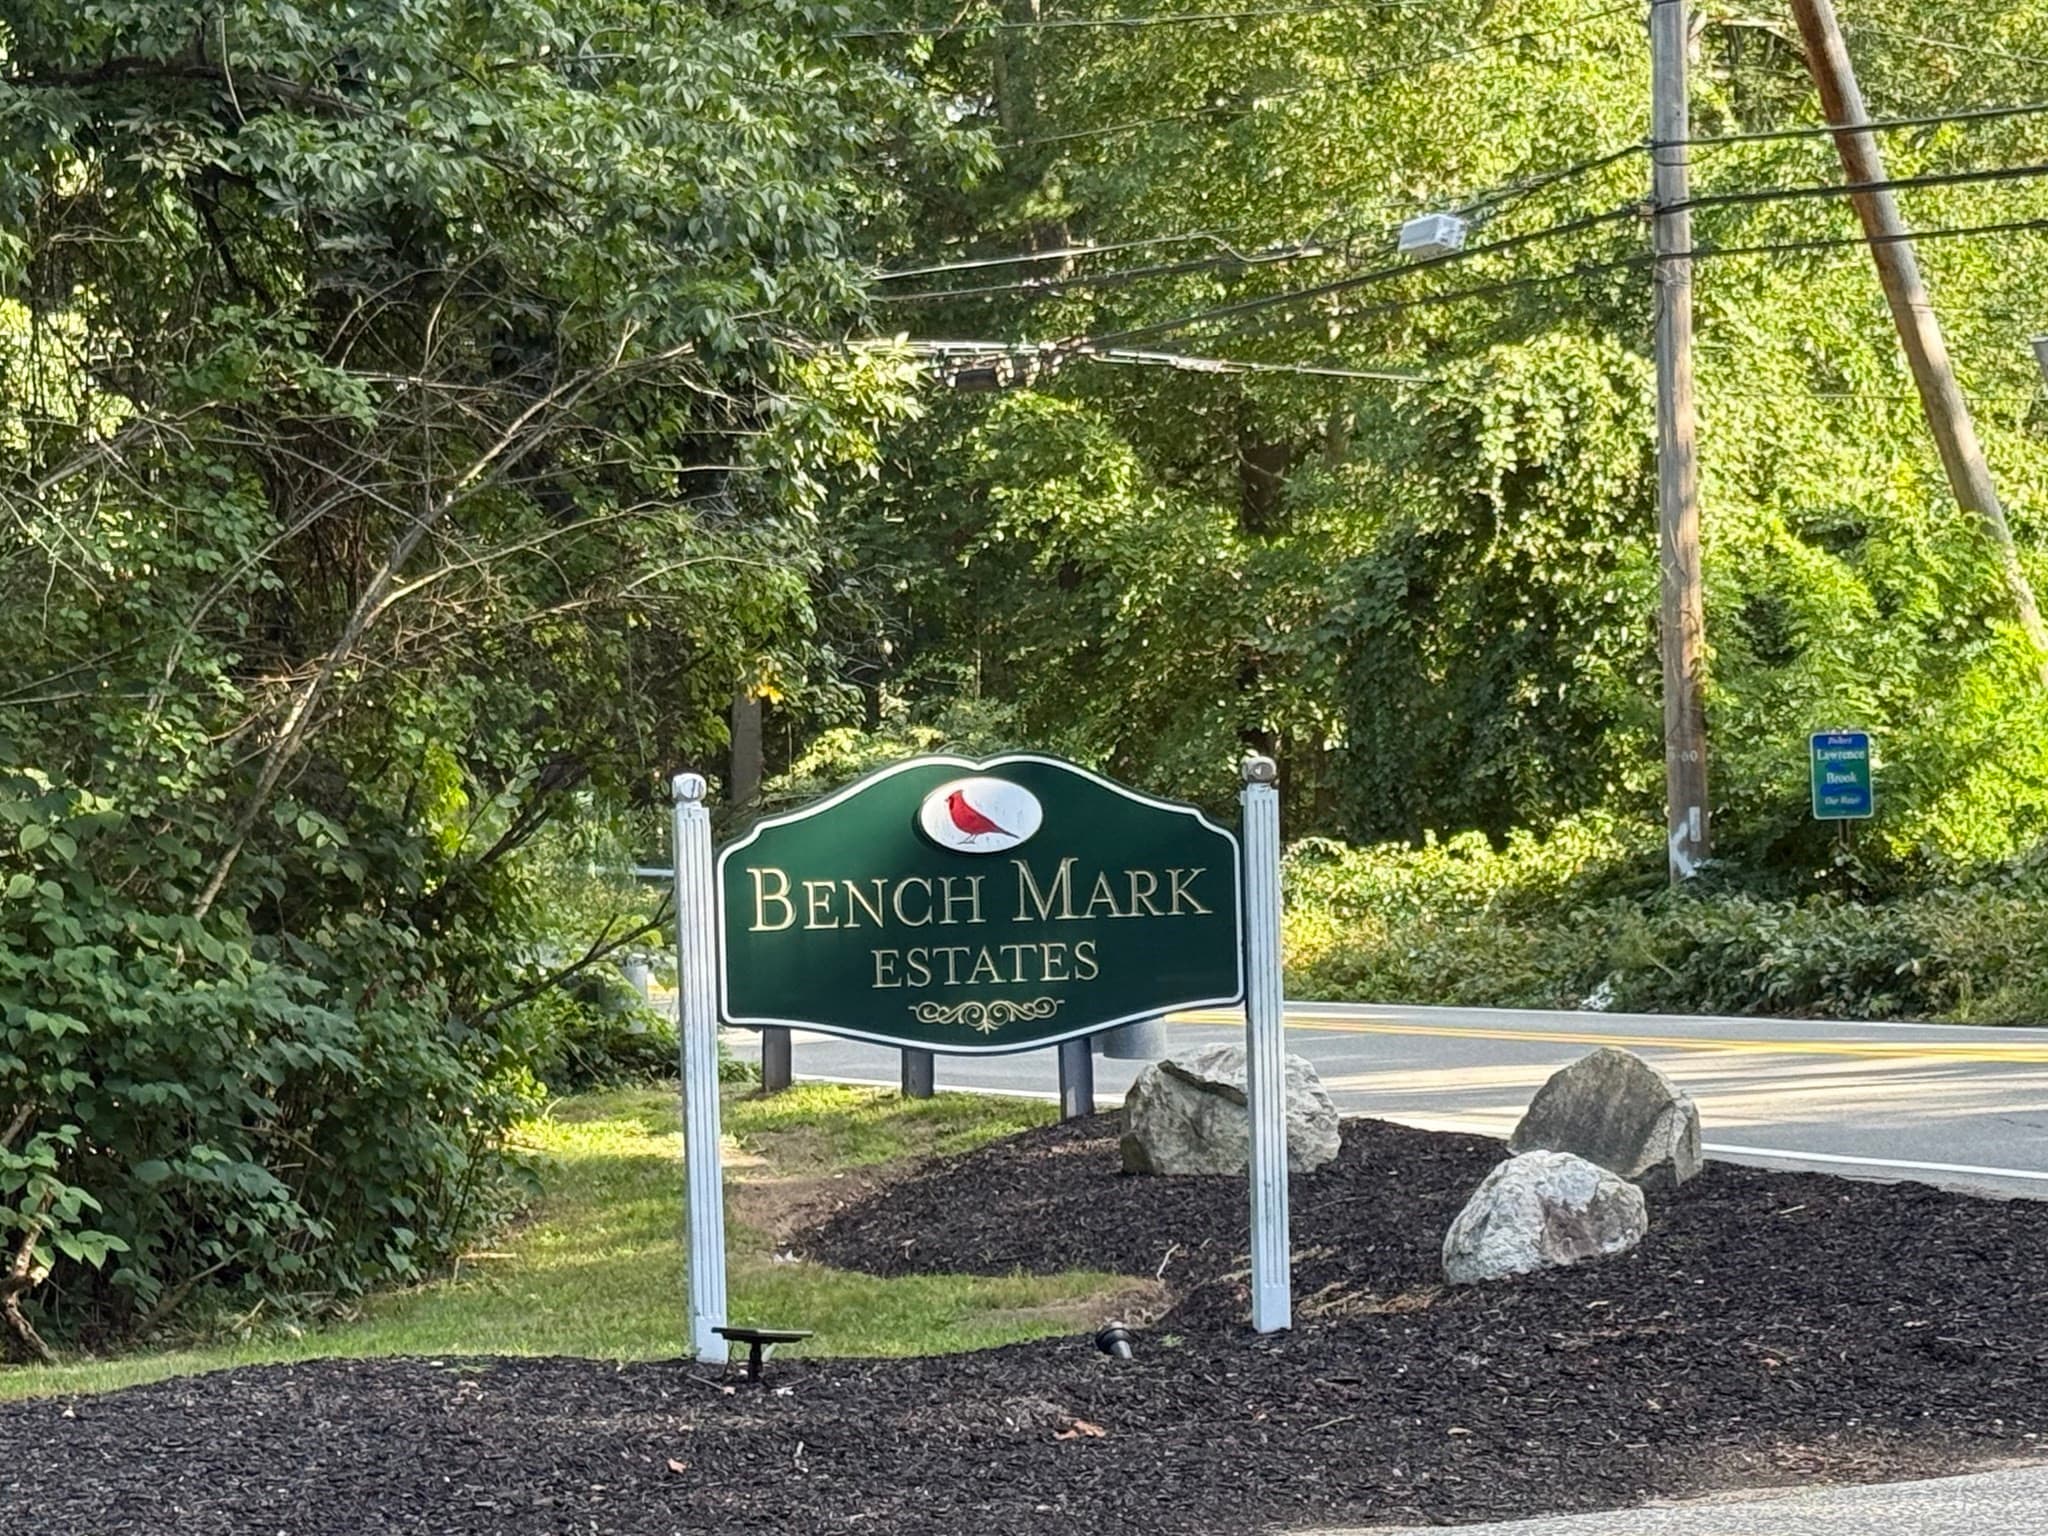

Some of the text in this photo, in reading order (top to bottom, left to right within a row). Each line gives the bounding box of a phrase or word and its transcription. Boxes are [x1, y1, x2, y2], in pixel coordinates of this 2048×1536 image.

[1816, 749, 1866, 761] Lawrence
[1826, 771, 1857, 784] Brook
[746, 857, 1212, 932] BENCH MARK
[871, 940, 1100, 989] ESTATES
